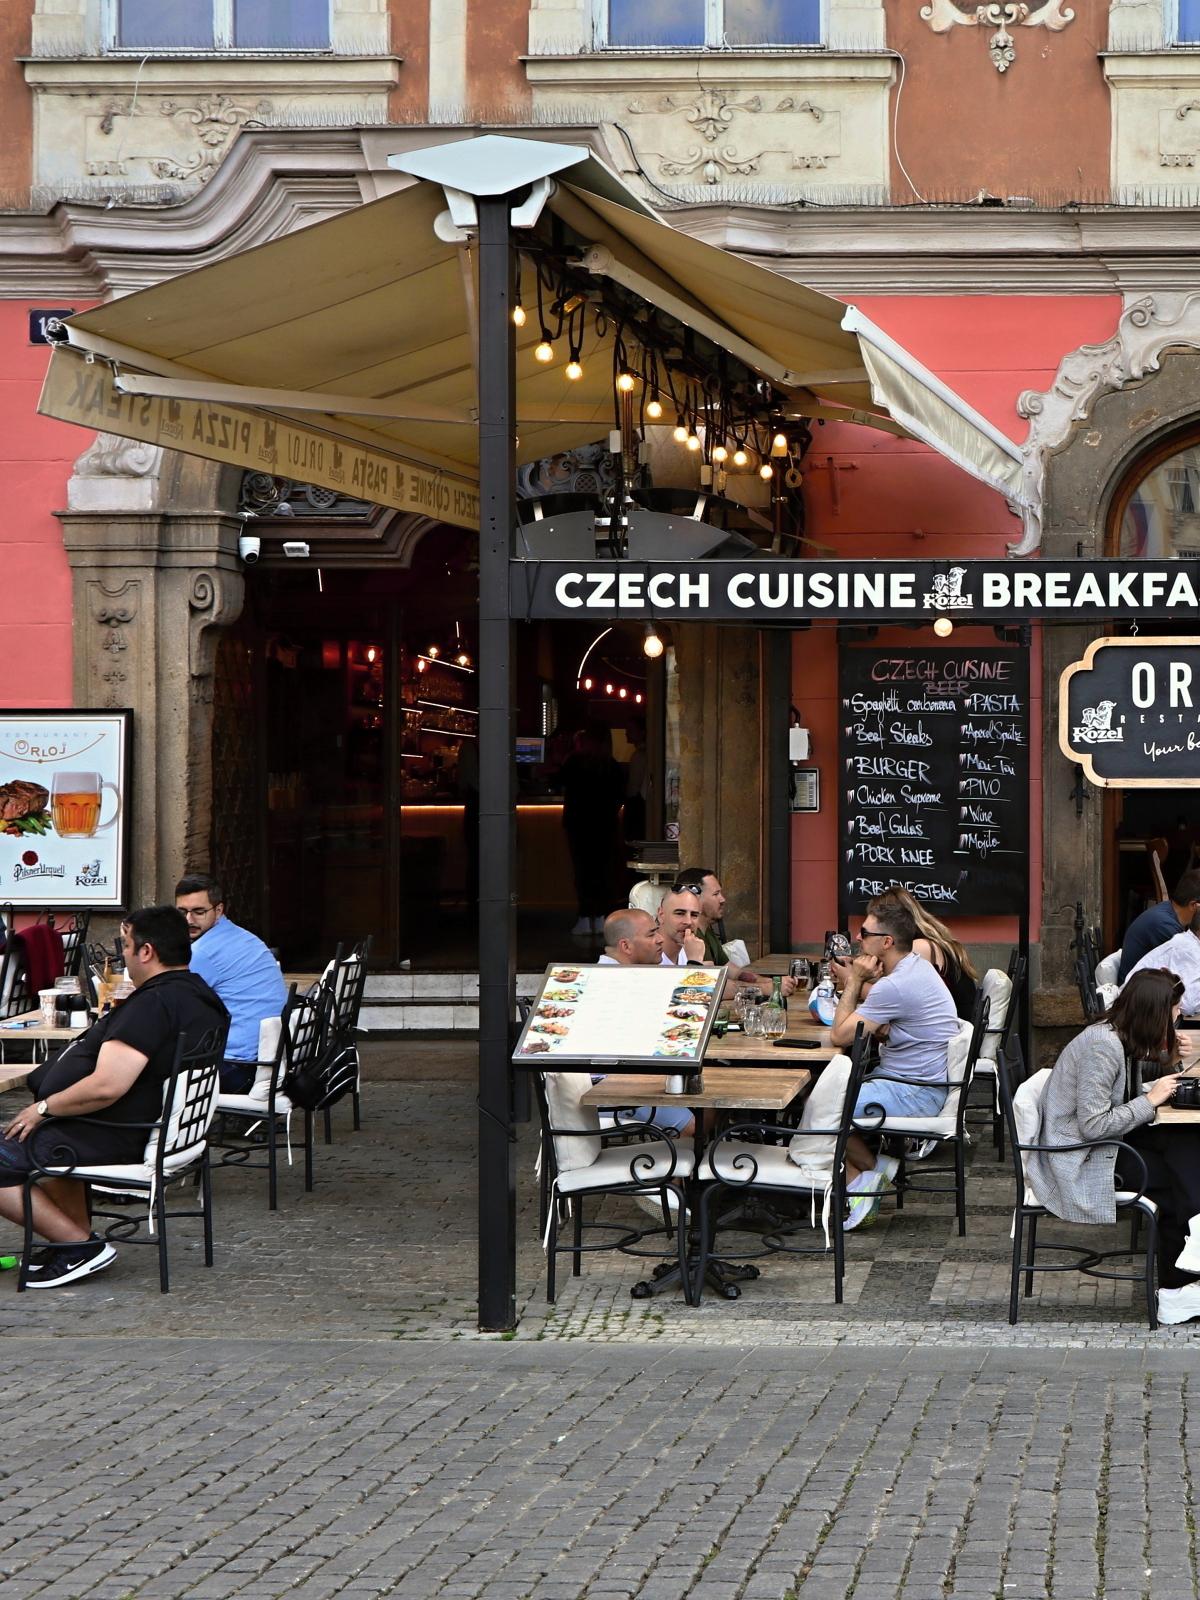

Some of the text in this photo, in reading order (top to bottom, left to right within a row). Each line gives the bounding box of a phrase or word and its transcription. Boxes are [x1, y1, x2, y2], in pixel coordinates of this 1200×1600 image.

[555, 572, 709, 608] CZECH
[727, 572, 915, 608] CUISINE
[923, 592, 974, 610] Kozel
[871, 659, 1016, 682] CZECH CUISINE
[922, 681, 970, 696] BEER
[851, 689, 904, 723] Spaghetti
[970, 694, 1024, 712] PASTA
[853, 720, 933, 749] Beef Steaks
[1072, 726, 1124, 743] Kozel
[1143, 740, 1183, 762] Your
[854, 756, 932, 785] BURGER
[966, 778, 1000, 796] PIVO
[856, 785, 944, 814] Chicken Supreme
[969, 805, 998, 824] Wine
[855, 812, 888, 843] Beef
[856, 843, 935, 866] PORK KNEE
[968, 831, 1001, 859] Mojito
[13, 863, 65, 882] Pilsner Urquell
[75, 876, 107, 887] Kozel
[915, 883, 960, 904] STEAK
